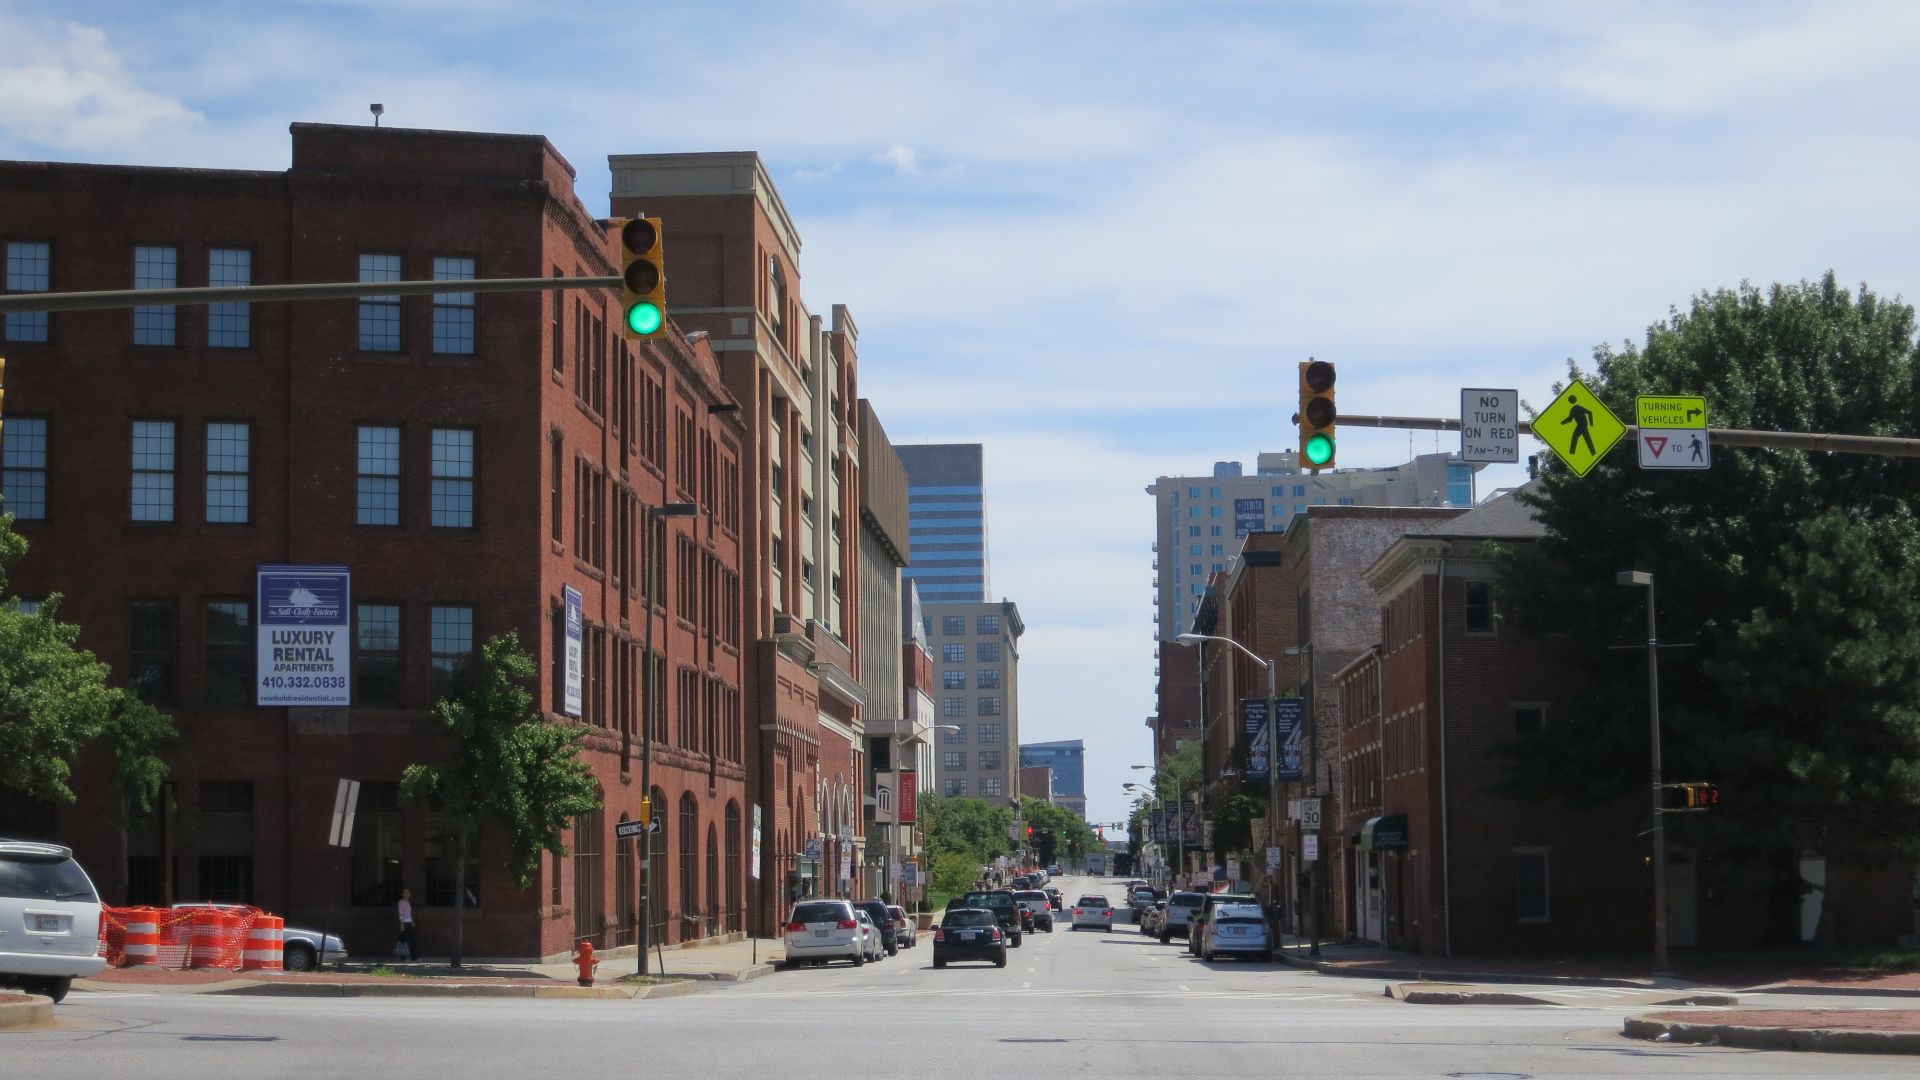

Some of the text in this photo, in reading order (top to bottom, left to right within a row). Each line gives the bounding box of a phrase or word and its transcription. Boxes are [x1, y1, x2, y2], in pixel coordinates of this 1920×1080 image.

[1480, 397, 1499, 408] NO
[1643, 403, 1682, 412] TURNING
[1474, 412, 1506, 423] TURN
[1642, 415, 1685, 425] VEHICLES
[1465, 427, 1514, 439] ON RED
[1671, 444, 1683, 453] TO
[272, 630, 335, 645] LUXURY
[273, 647, 334, 662] RENTAL
[273, 663, 335, 672] APARTMENTS
[262, 676, 346, 688] 410.332.0838
[1304, 812, 1319, 824] 30
